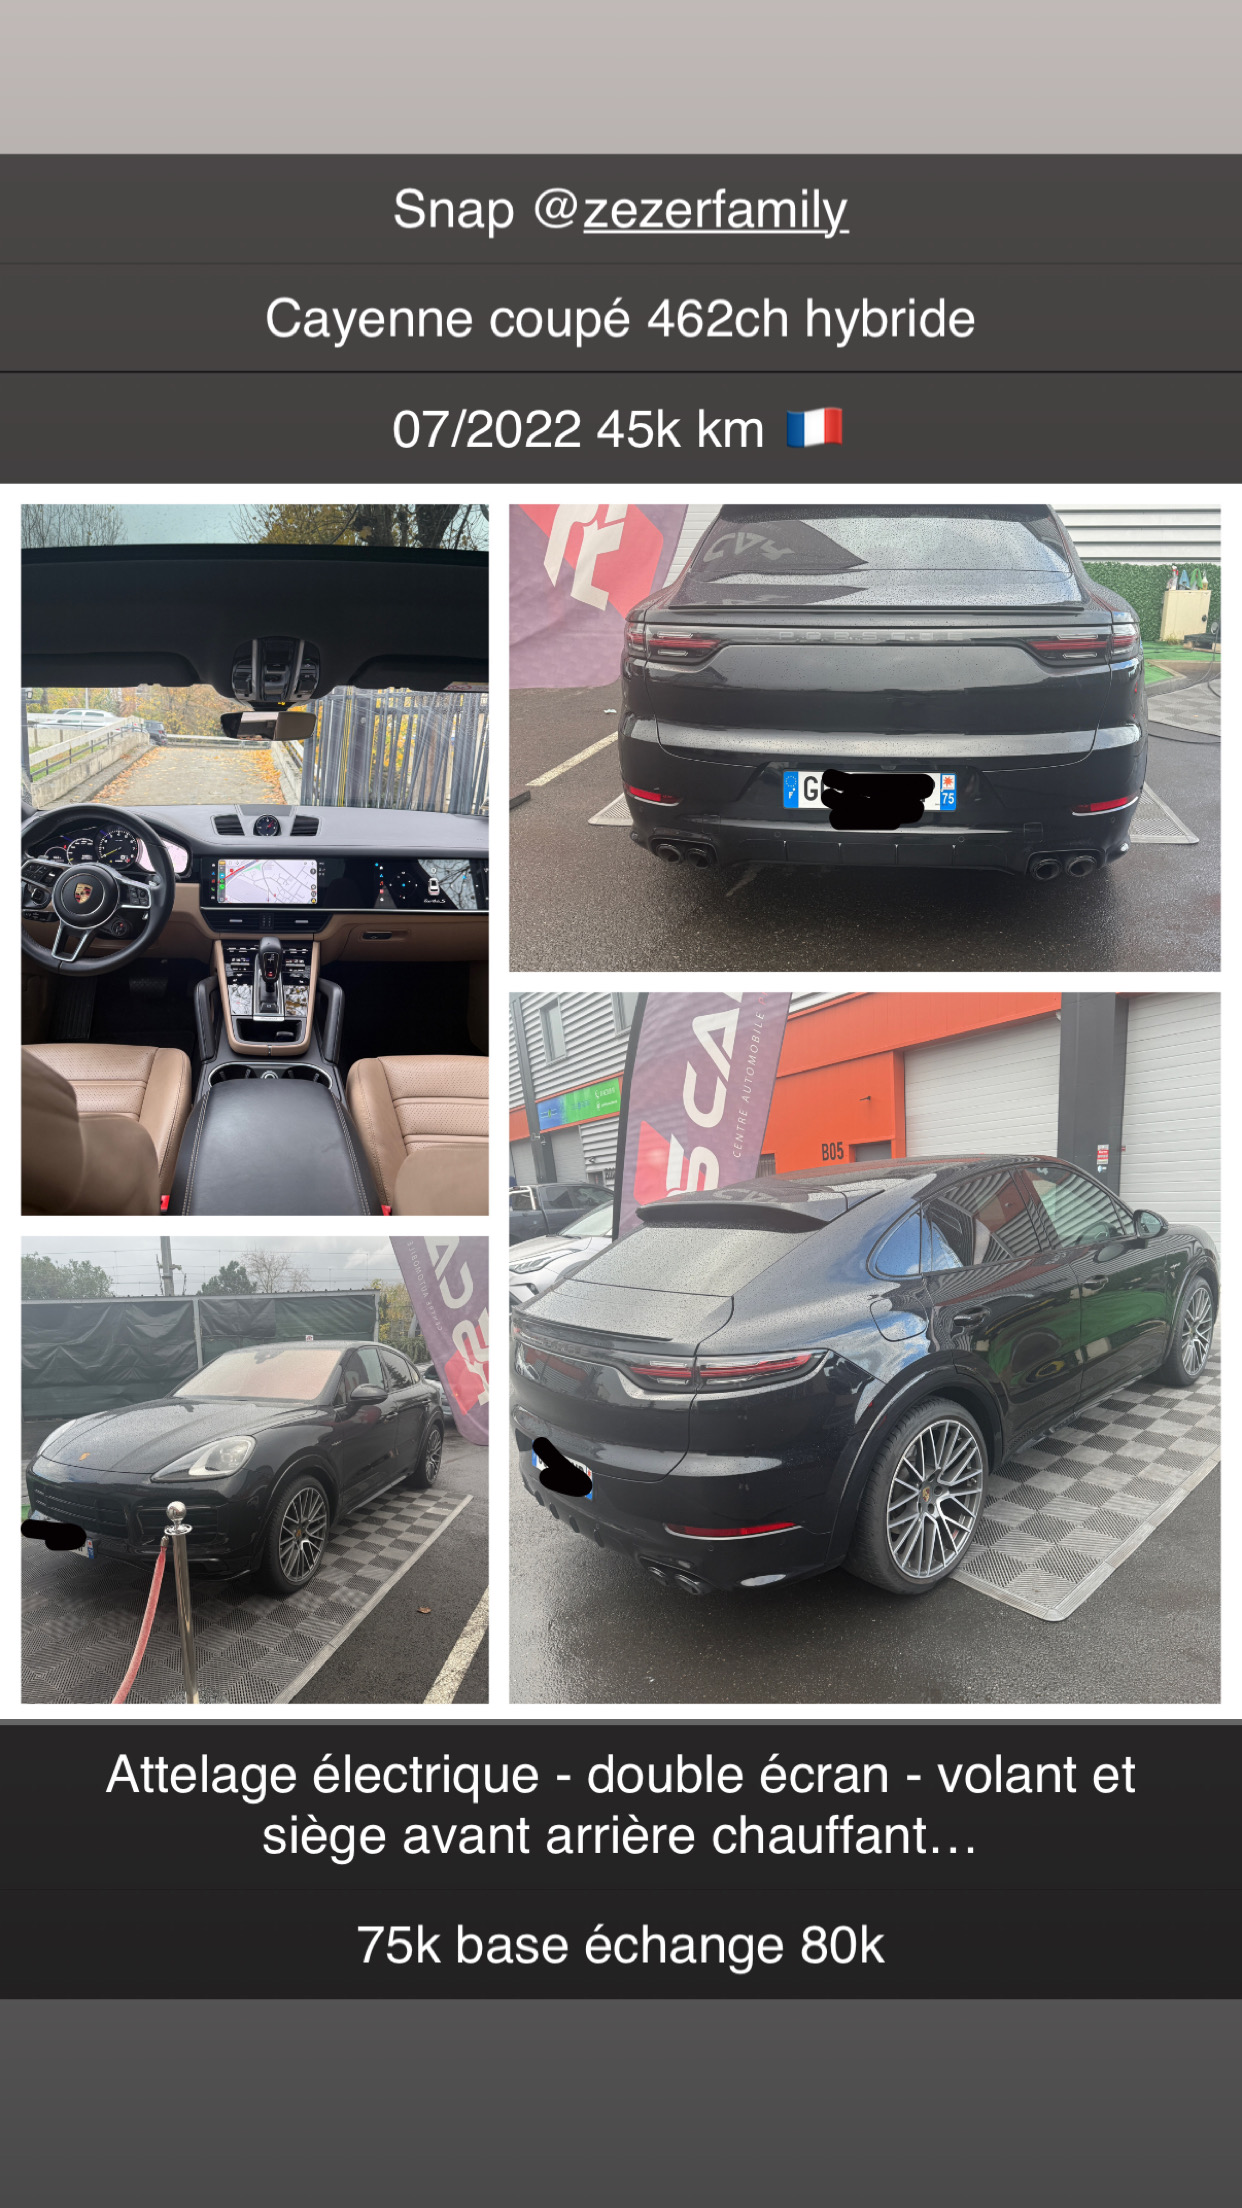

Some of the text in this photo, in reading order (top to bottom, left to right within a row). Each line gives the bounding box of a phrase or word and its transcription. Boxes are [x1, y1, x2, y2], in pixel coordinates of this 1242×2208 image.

[941, 792, 956, 804] 75
[683, 992, 743, 1128] CA
[732, 1109, 748, 1158] CENTRE
[741, 1011, 765, 1103] AUTOMOBILE
[821, 1141, 845, 1161] B05
